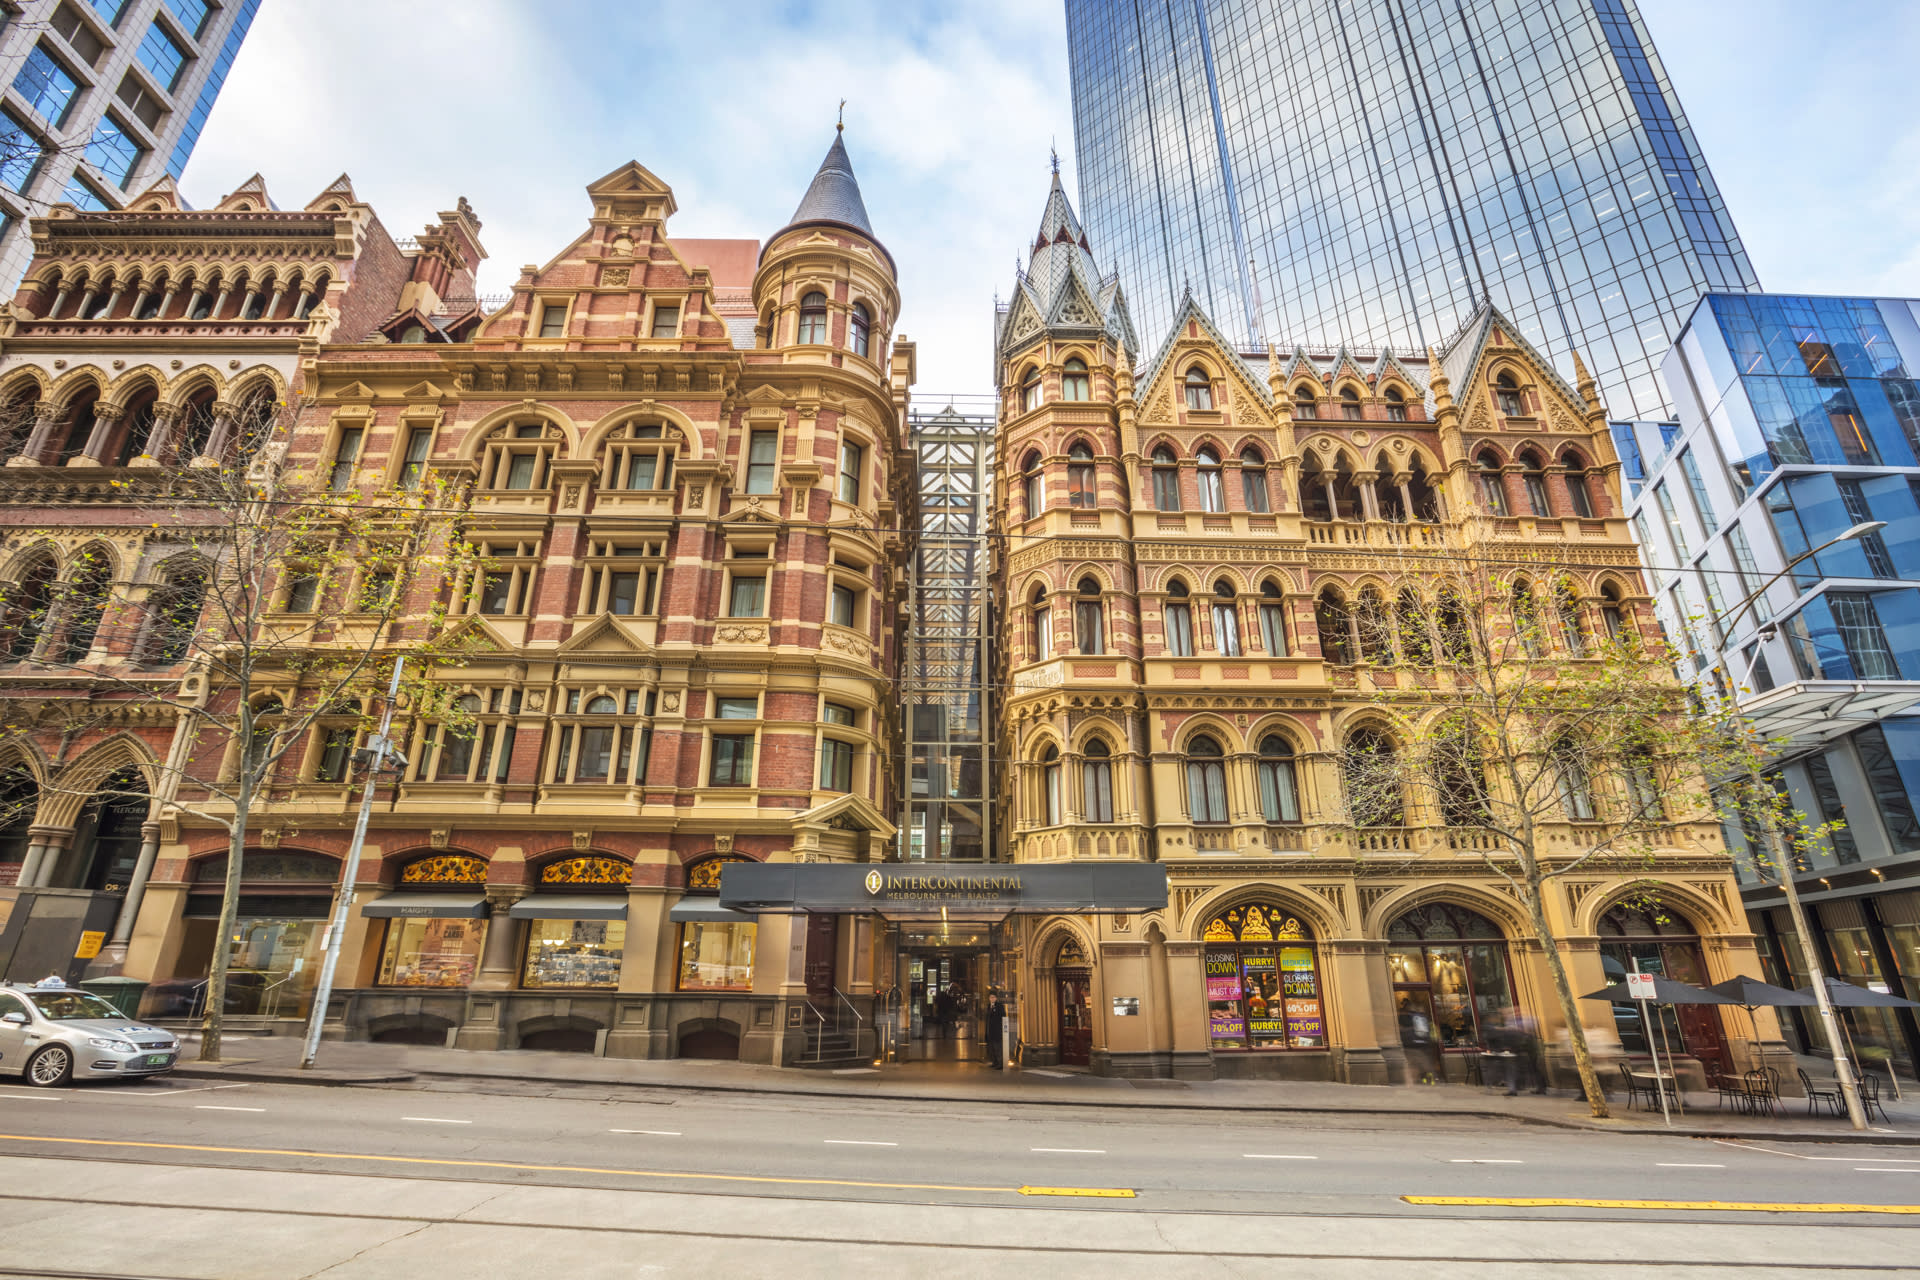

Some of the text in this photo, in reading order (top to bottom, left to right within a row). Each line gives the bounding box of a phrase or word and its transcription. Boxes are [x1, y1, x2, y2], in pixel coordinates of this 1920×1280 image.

[886, 892, 942, 900] MELBOURNE
[967, 892, 1000, 900] RIALTO
[1206, 953, 1236, 962] CLOSING
[1243, 957, 1275, 966] HURRY!
[1207, 962, 1237, 974] DOWN
[1284, 975, 1314, 984] CLOSING
[1209, 988, 1228, 996] MUST
[1285, 983, 1315, 995] DOWN
[1304, 1004, 1317, 1013] OFF
[1212, 1023, 1243, 1033] 70% OFF
[1250, 1021, 1282, 1030] HURRY!
[1289, 1022, 1319, 1031] 70% OFF
